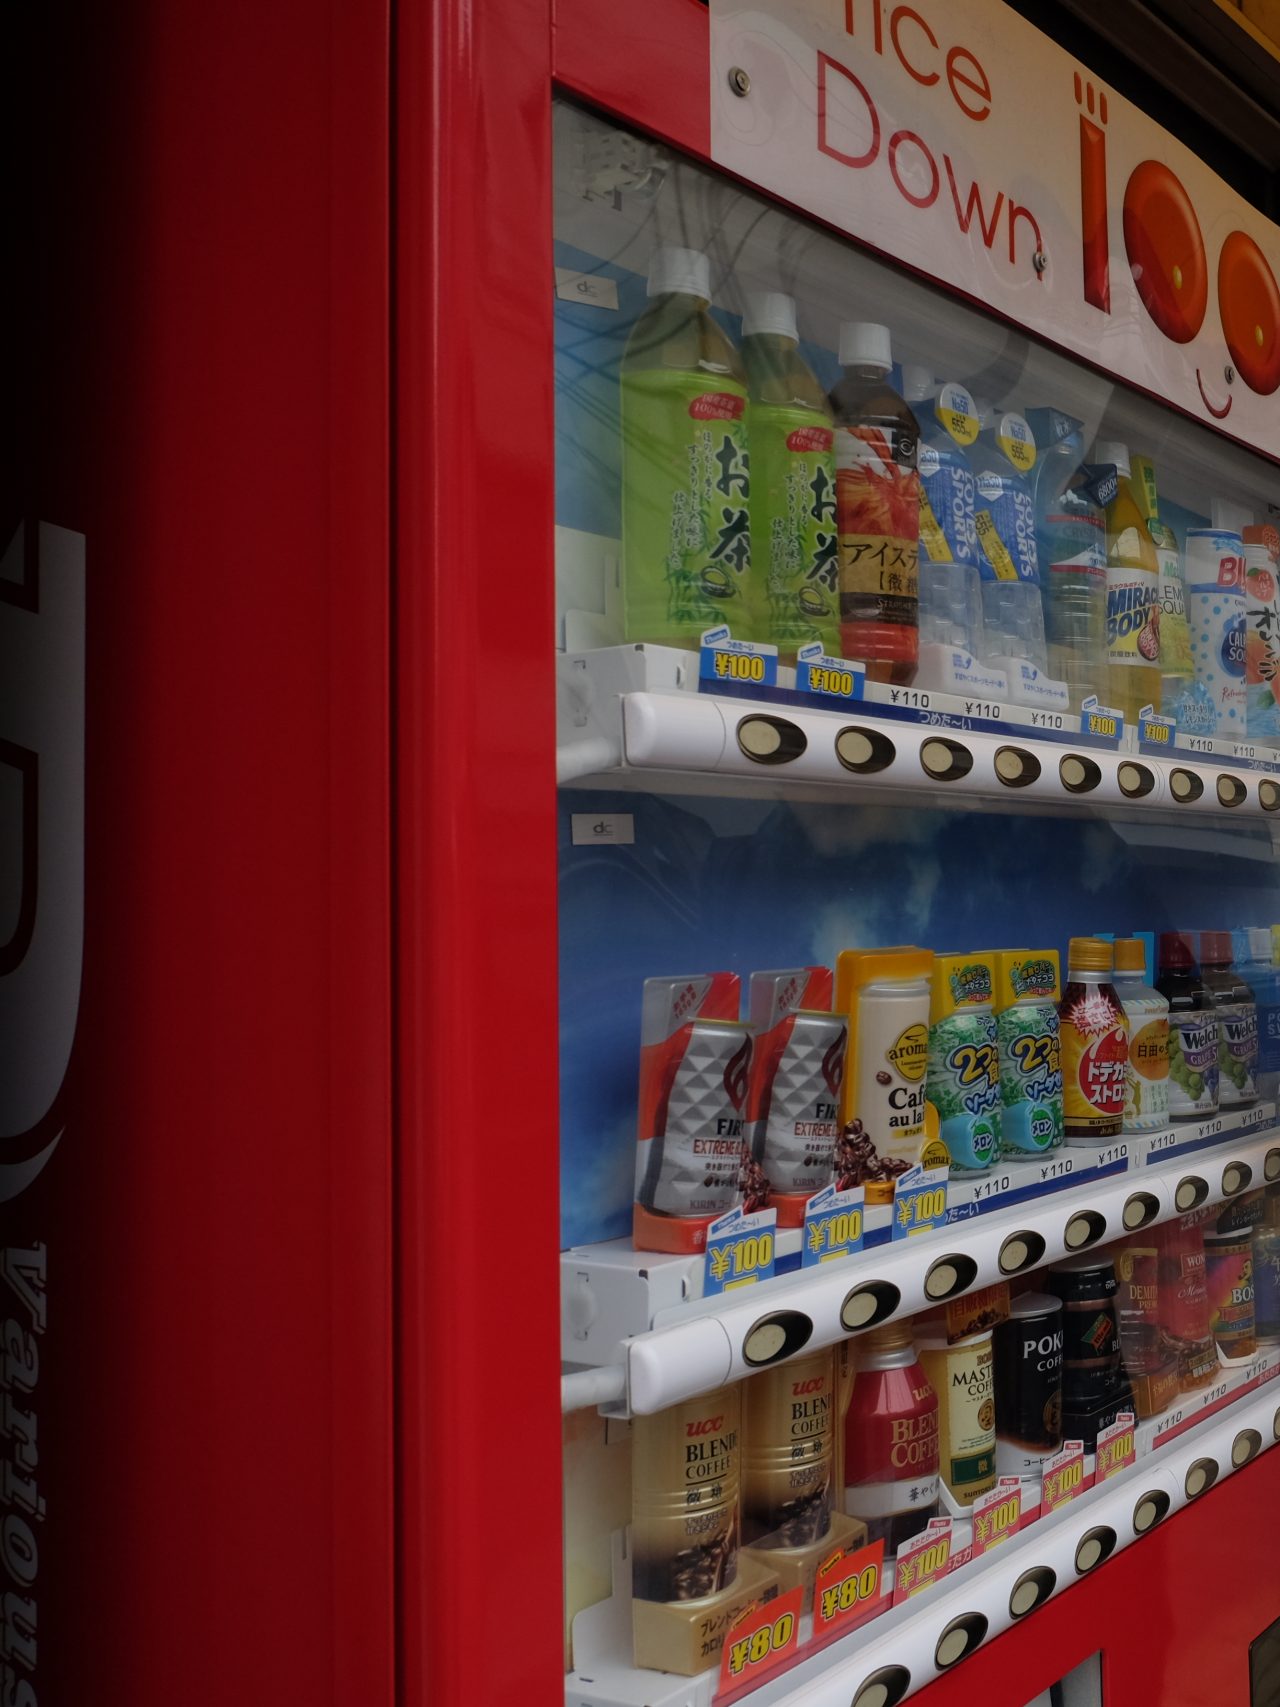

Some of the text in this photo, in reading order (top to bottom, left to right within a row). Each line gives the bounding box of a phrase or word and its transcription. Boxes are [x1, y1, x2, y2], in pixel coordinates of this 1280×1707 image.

[817, 49, 1043, 281] Down
[709, 435, 750, 573] お茶
[951, 466, 971, 559] SPORTS
[1013, 490, 1033, 577] SPORTS
[1107, 608, 1151, 647] BODY
[715, 651, 765, 682] ¥100
[810, 665, 854, 696] ¥100
[890, 689, 1063, 729] ¥110 ¥110 ¥110
[1088, 713, 1117, 738] ¥100
[1144, 722, 1169, 744] ¥100
[1189, 738, 1213, 752] ¥110
[1233, 745, 1255, 758] ¥110
[592, 821, 614, 834] dc
[717, 1118, 742, 1137] FIR
[815, 1102, 838, 1119] FIR
[888, 1115, 909, 1128] au
[1031, 1119, 1053, 1137] メロン
[973, 1133, 993, 1152] メロン
[973, 1109, 1263, 1200] ¥110 ¥110 ¥110 ¥110 ¥110 ¥110
[895, 1186, 947, 1228] ¥100
[808, 1209, 863, 1253] ¥100
[711, 1232, 774, 1281] ¥100
[952, 1364, 993, 1387] MAST
[1157, 1410, 1183, 1434] ¥110
[1203, 1383, 1227, 1405] ¥110
[1246, 1359, 1268, 1380] ¥110
[1098, 1433, 1134, 1471] ¥100
[1043, 1459, 1082, 1505] ¥100
[976, 1496, 1020, 1544] ¥100
[899, 1539, 950, 1591] ¥100
[822, 1564, 877, 1620] ¥80
[730, 1613, 794, 1675] ¥80
